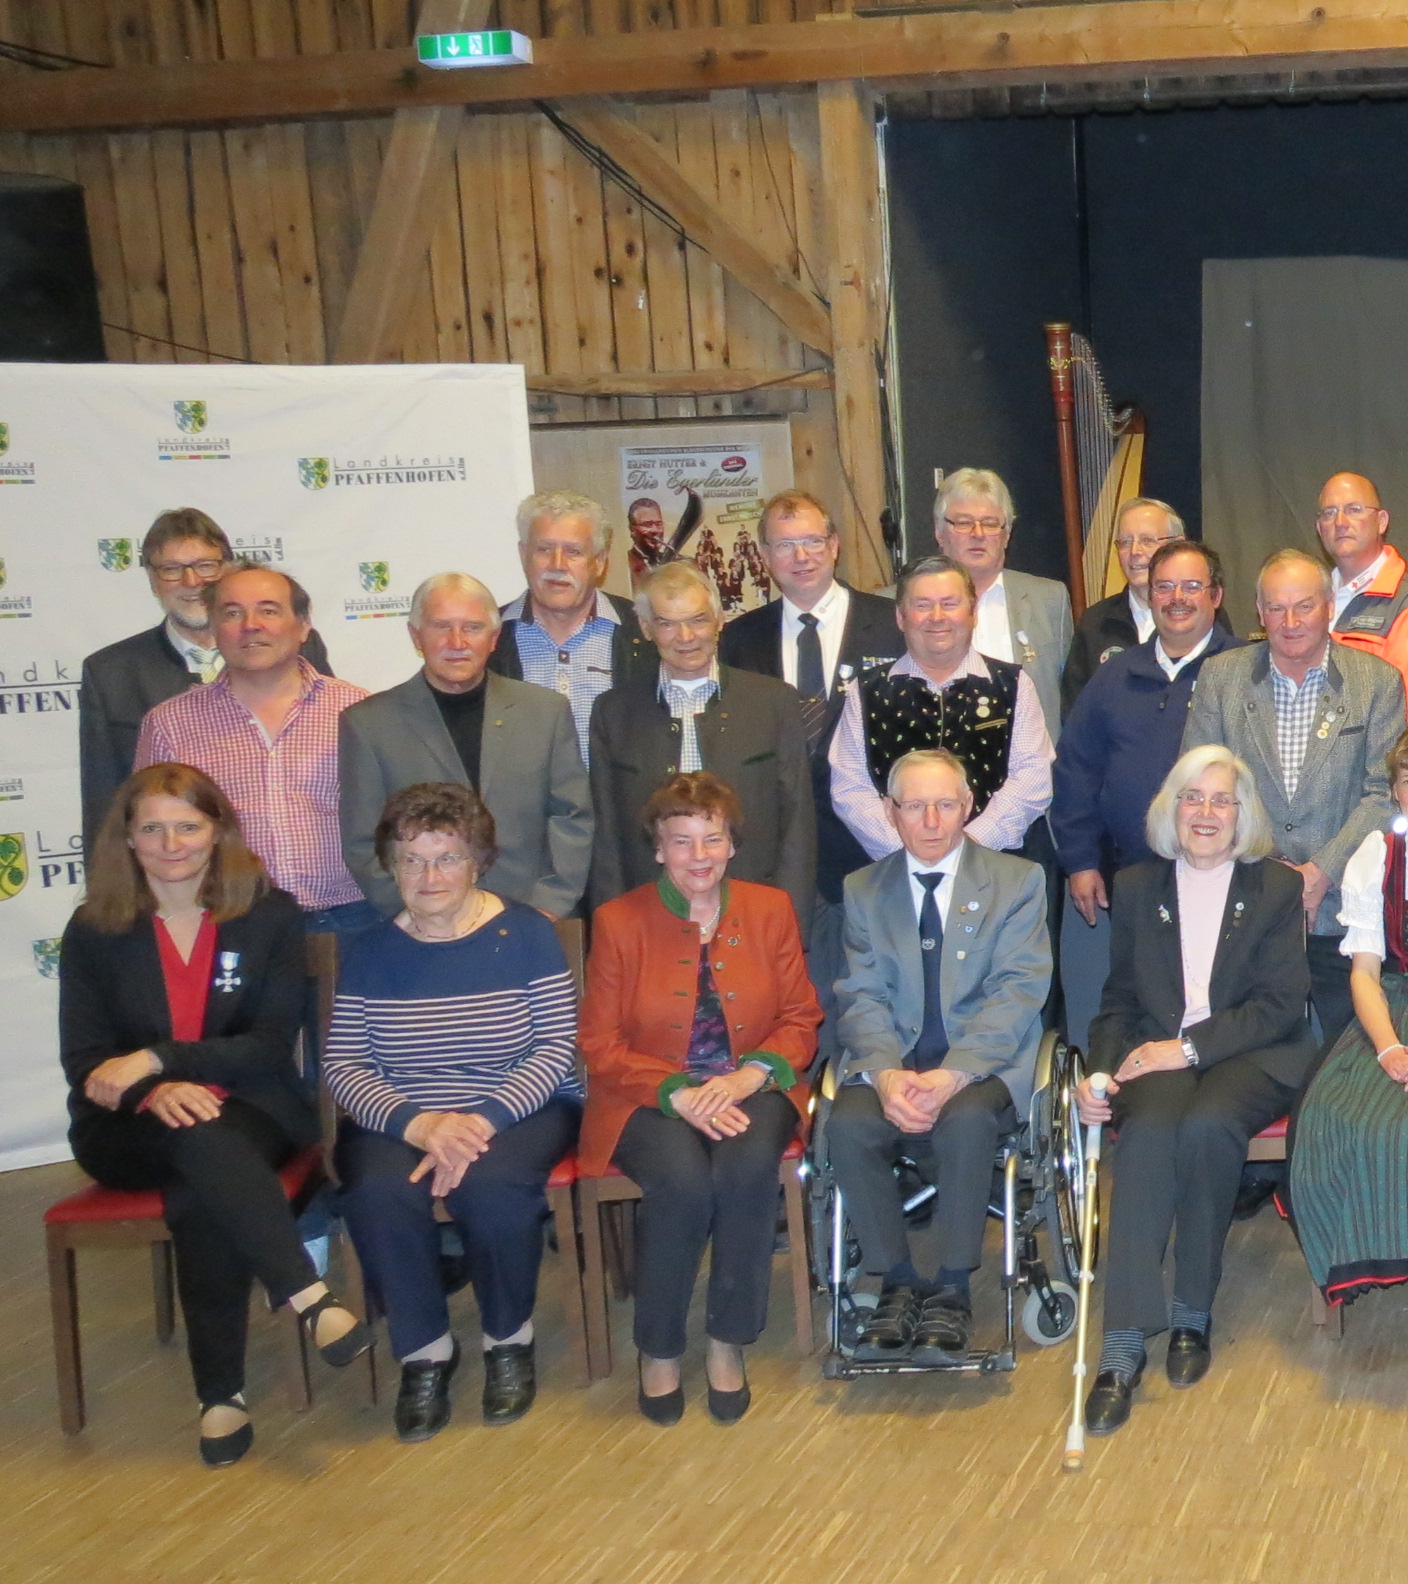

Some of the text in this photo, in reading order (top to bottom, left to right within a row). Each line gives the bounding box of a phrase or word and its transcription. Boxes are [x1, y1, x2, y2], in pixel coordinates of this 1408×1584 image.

[333, 455, 455, 469] Landkreis
[334, 469, 456, 486] PFAFFENHOFEN
[625, 468, 758, 496] Die Egerländer
